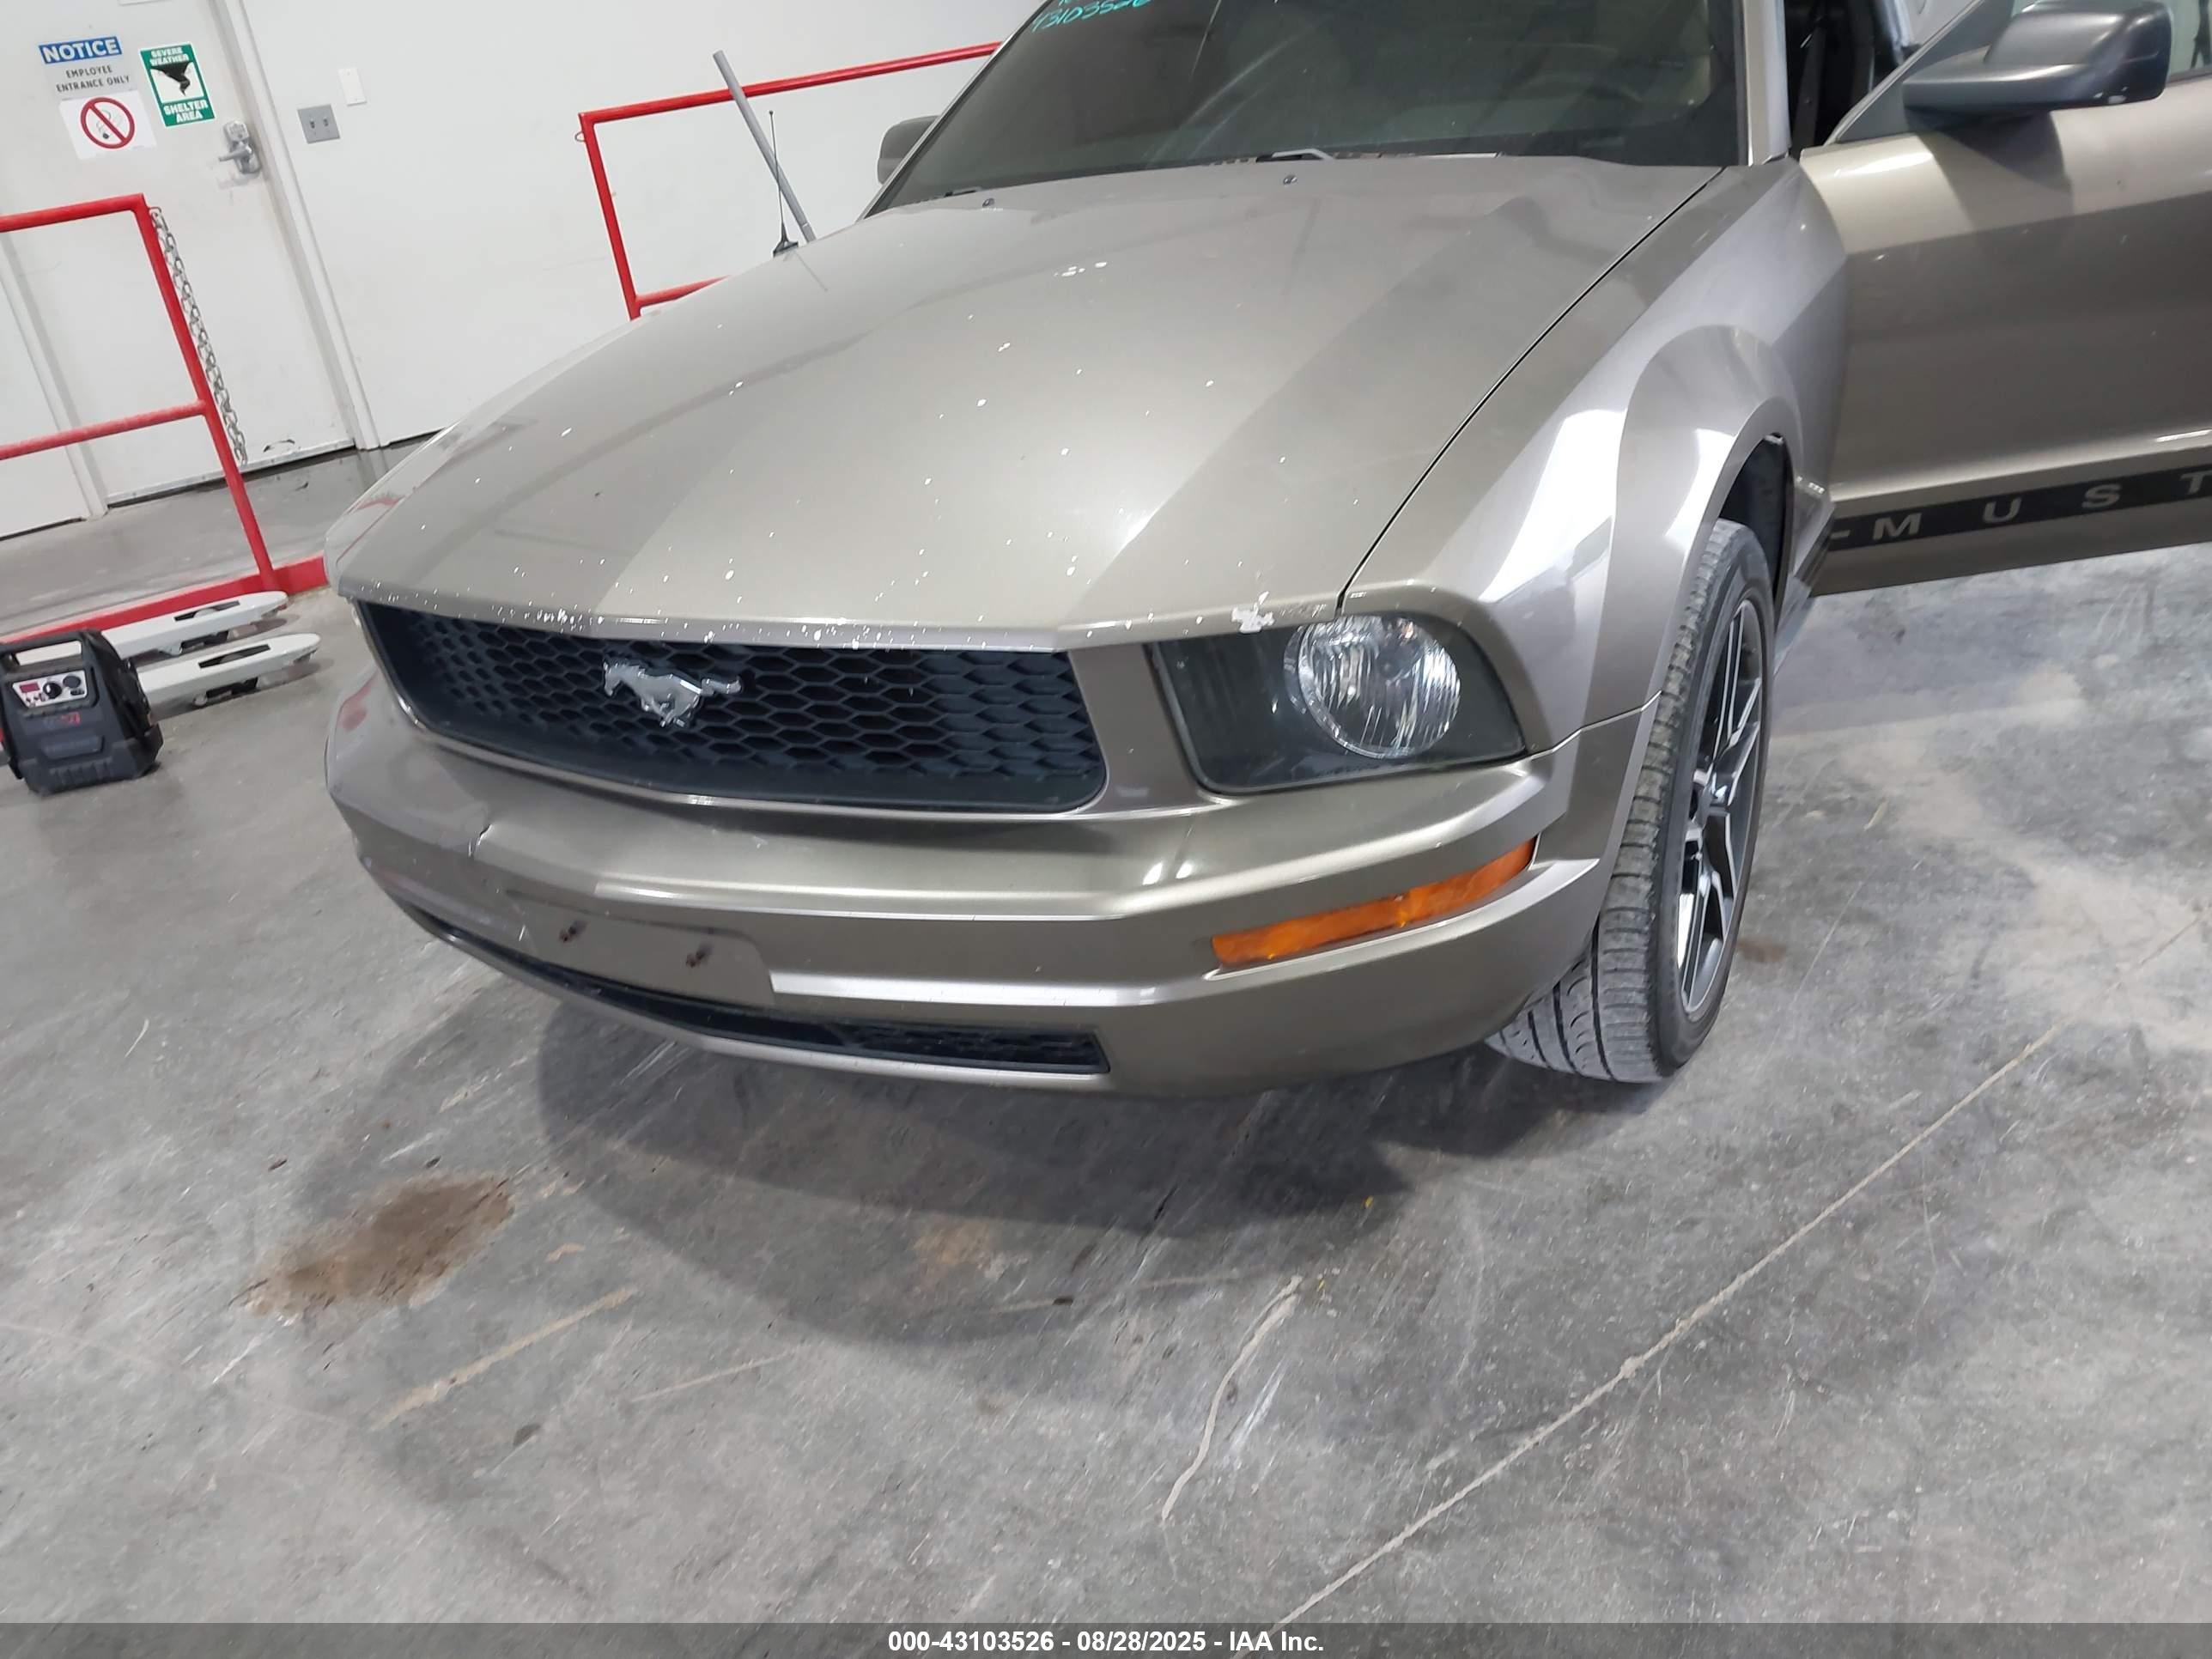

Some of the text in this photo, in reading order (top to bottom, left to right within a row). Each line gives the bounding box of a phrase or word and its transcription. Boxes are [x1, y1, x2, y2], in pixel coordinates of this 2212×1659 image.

[42, 38, 119, 63] NOTICE
[150, 46, 183, 58] SEVERE
[149, 53, 190, 66] WEATHER
[65, 64, 112, 79] EMPLOYEE
[56, 75, 130, 93] ENTRANCE ONLY
[163, 100, 208, 116] SHELTER
[176, 109, 203, 123] AREA
